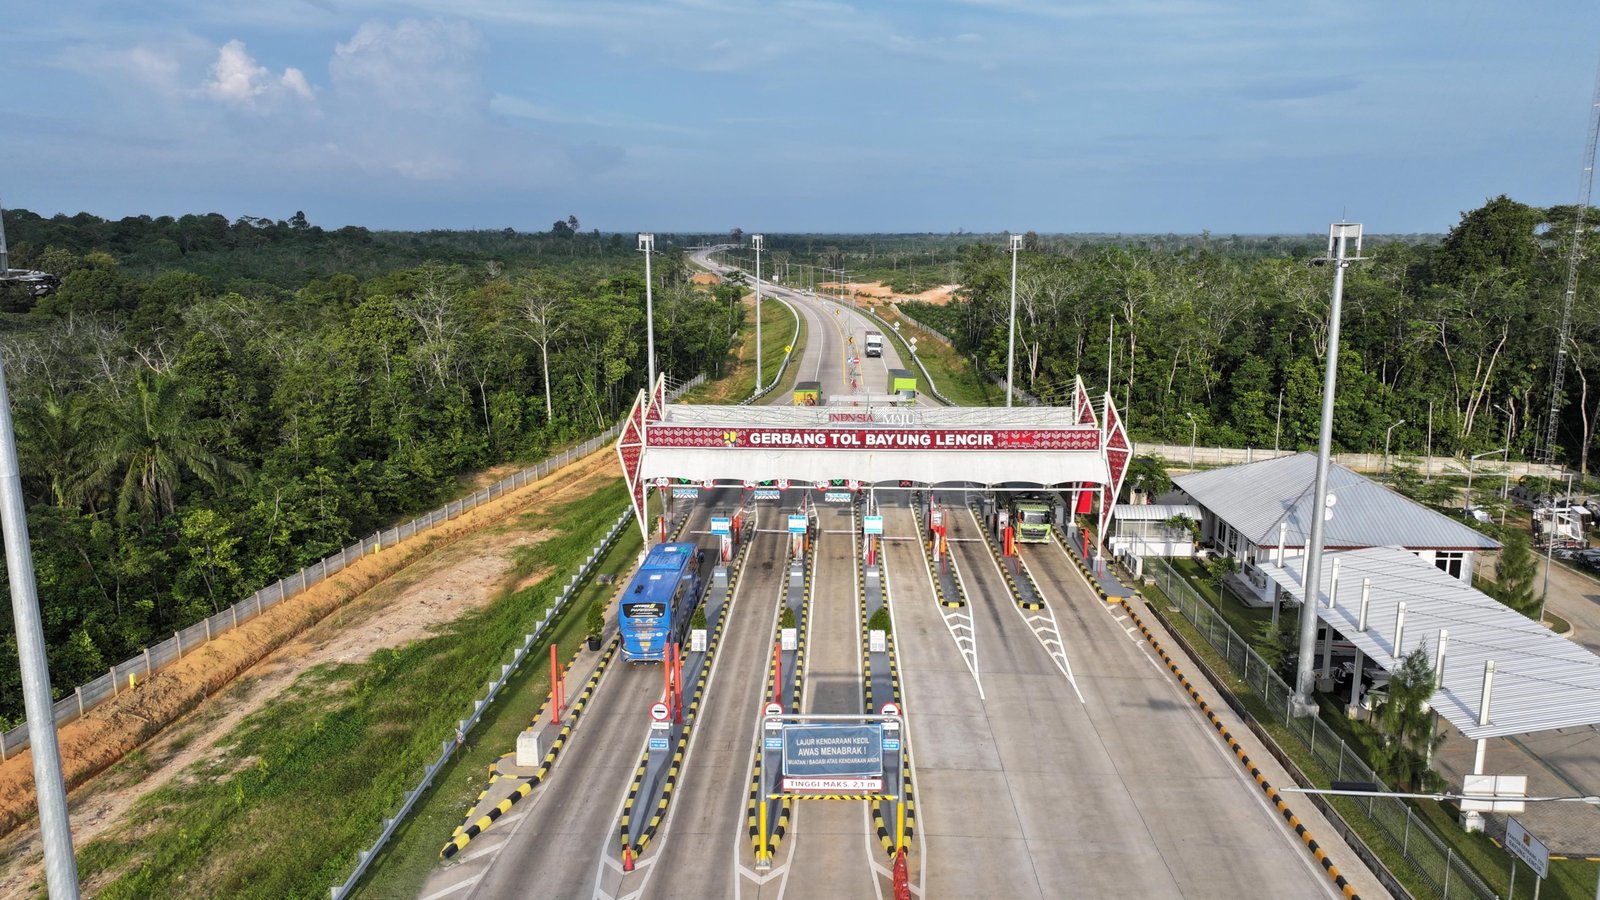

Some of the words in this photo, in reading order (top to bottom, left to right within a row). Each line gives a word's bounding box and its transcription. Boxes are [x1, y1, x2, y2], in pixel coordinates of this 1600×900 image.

[882, 414, 915, 427] MAJU
[750, 432, 826, 445] GERBANG
[830, 433, 861, 445] TOL
[865, 433, 931, 445] BAYUNG
[936, 433, 994, 446] LENCIR
[796, 738, 815, 746] LAJUR
[816, 738, 852, 746] KENDARAAN
[853, 737, 870, 745] KECIL
[798, 748, 820, 757] AWAS
[821, 747, 862, 756] MENABRAK
[790, 780, 820, 788] TINGGI
[823, 780, 850, 788] MAKS.
[853, 780, 865, 788] 2,1
